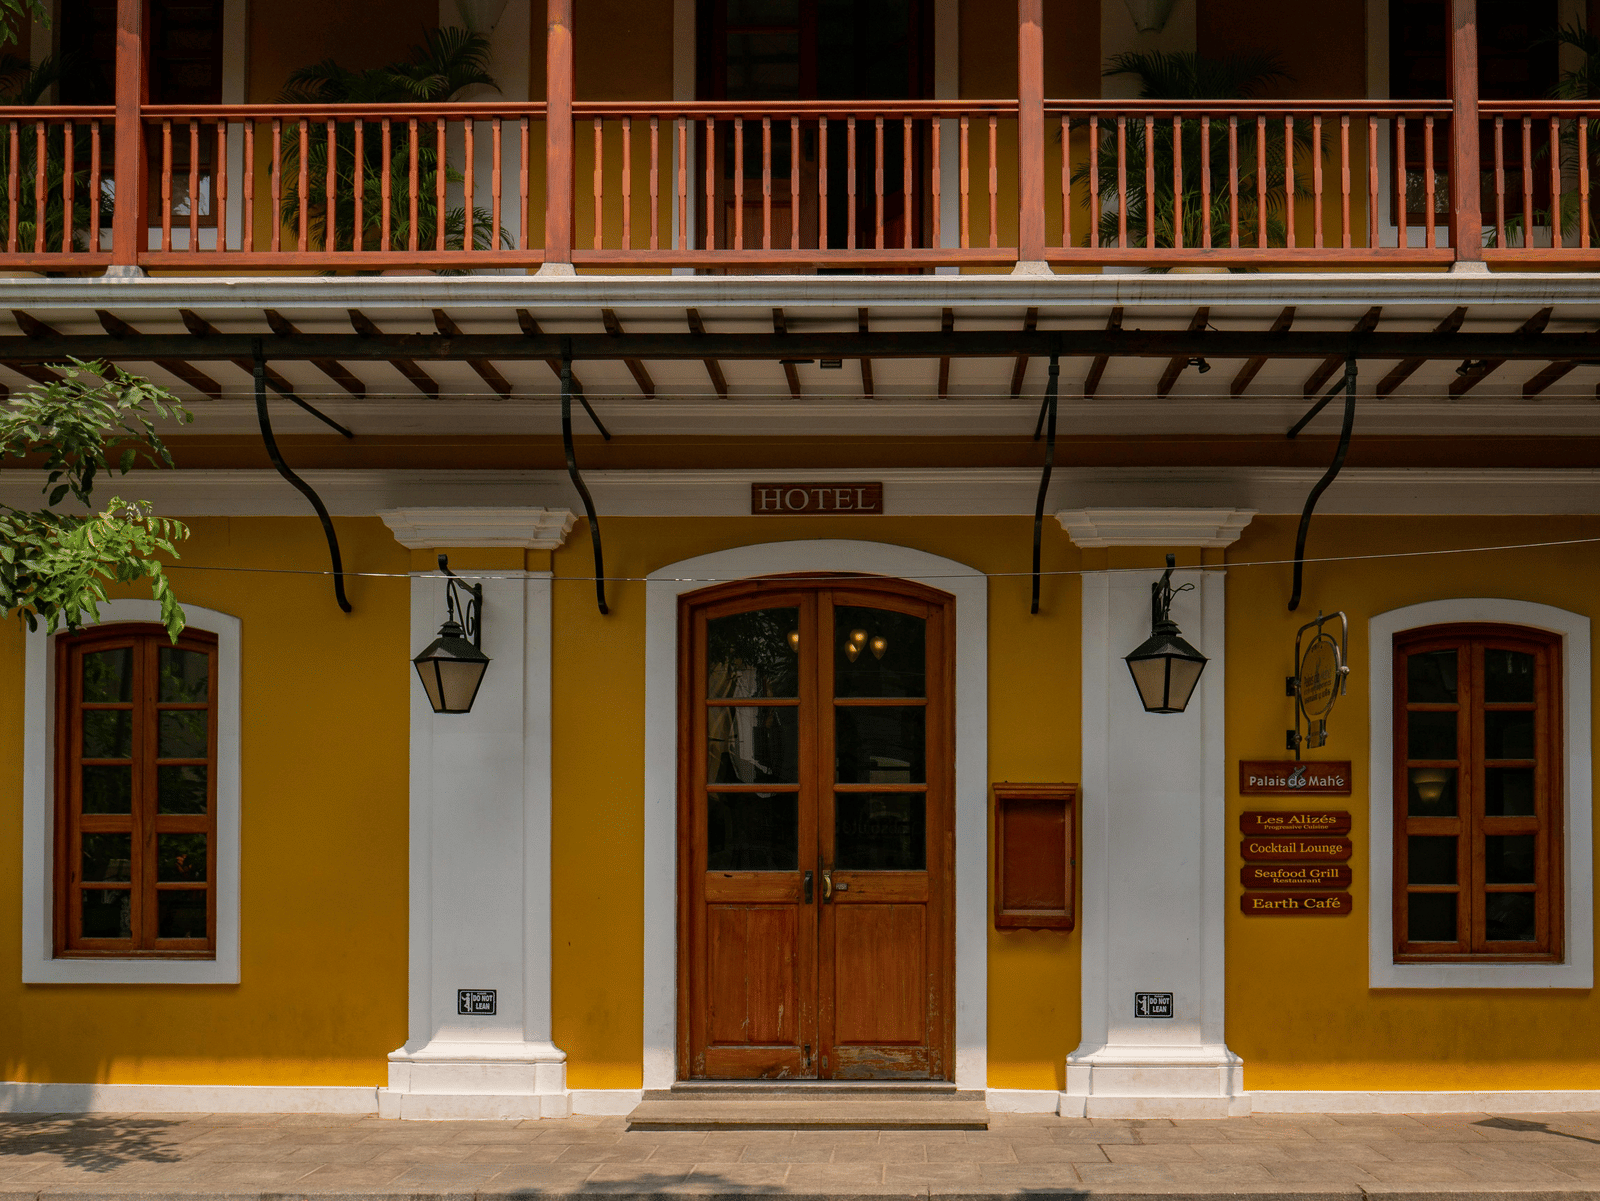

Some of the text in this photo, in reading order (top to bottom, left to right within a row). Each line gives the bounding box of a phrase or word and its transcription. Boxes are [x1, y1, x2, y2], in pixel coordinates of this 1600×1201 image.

[759, 488, 876, 511] HOTEL
[1249, 775, 1345, 787] Palais de Mahé
[1256, 814, 1337, 824] Les Alizés
[1249, 843, 1343, 855] Cocktail Lounge
[1254, 869, 1340, 878] Seafood Grill
[1252, 897, 1341, 909] Earth Café
